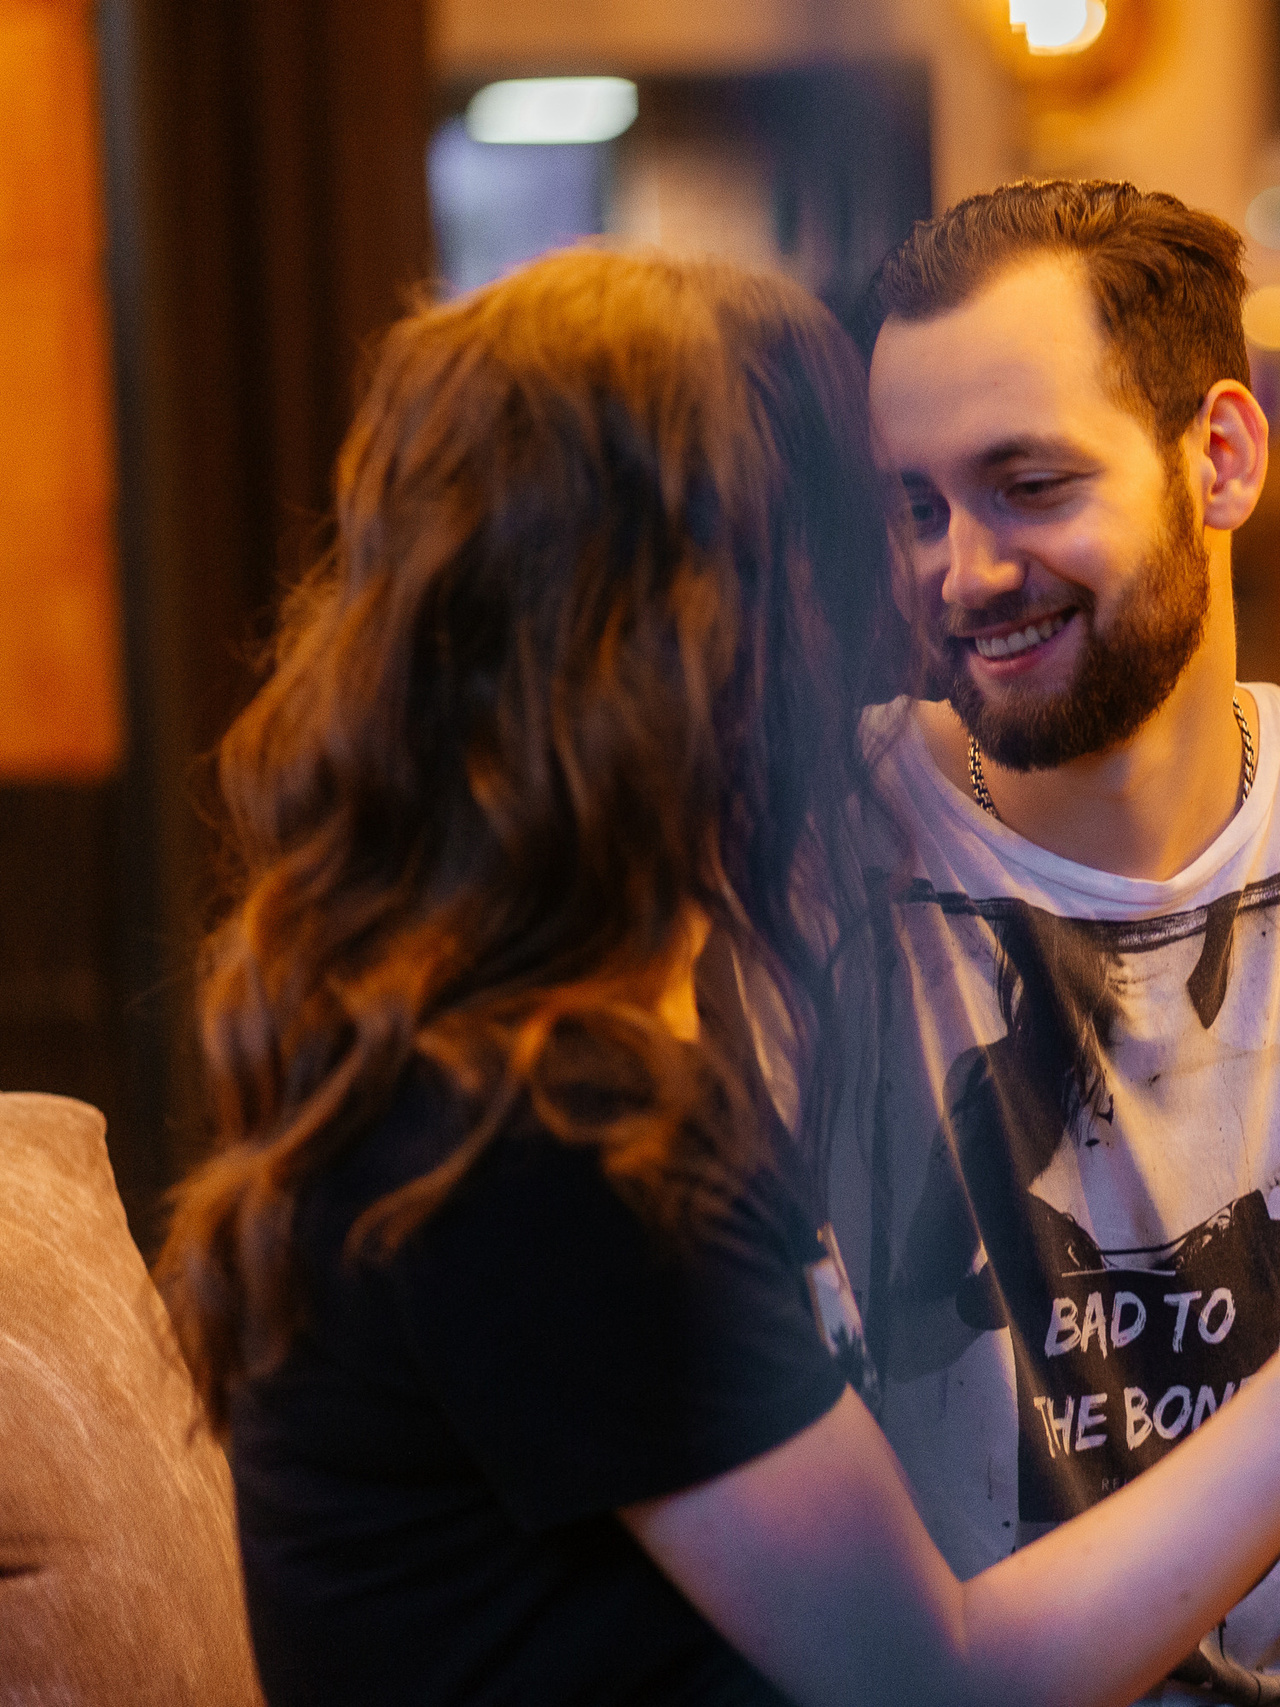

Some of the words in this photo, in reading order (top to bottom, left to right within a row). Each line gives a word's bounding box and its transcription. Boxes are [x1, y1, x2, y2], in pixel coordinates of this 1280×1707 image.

[1044, 1291, 1147, 1360] BAD
[1163, 1287, 1236, 1353] TO
[1033, 1393, 1108, 1458] THE
[1124, 1377, 1249, 1450] BON
